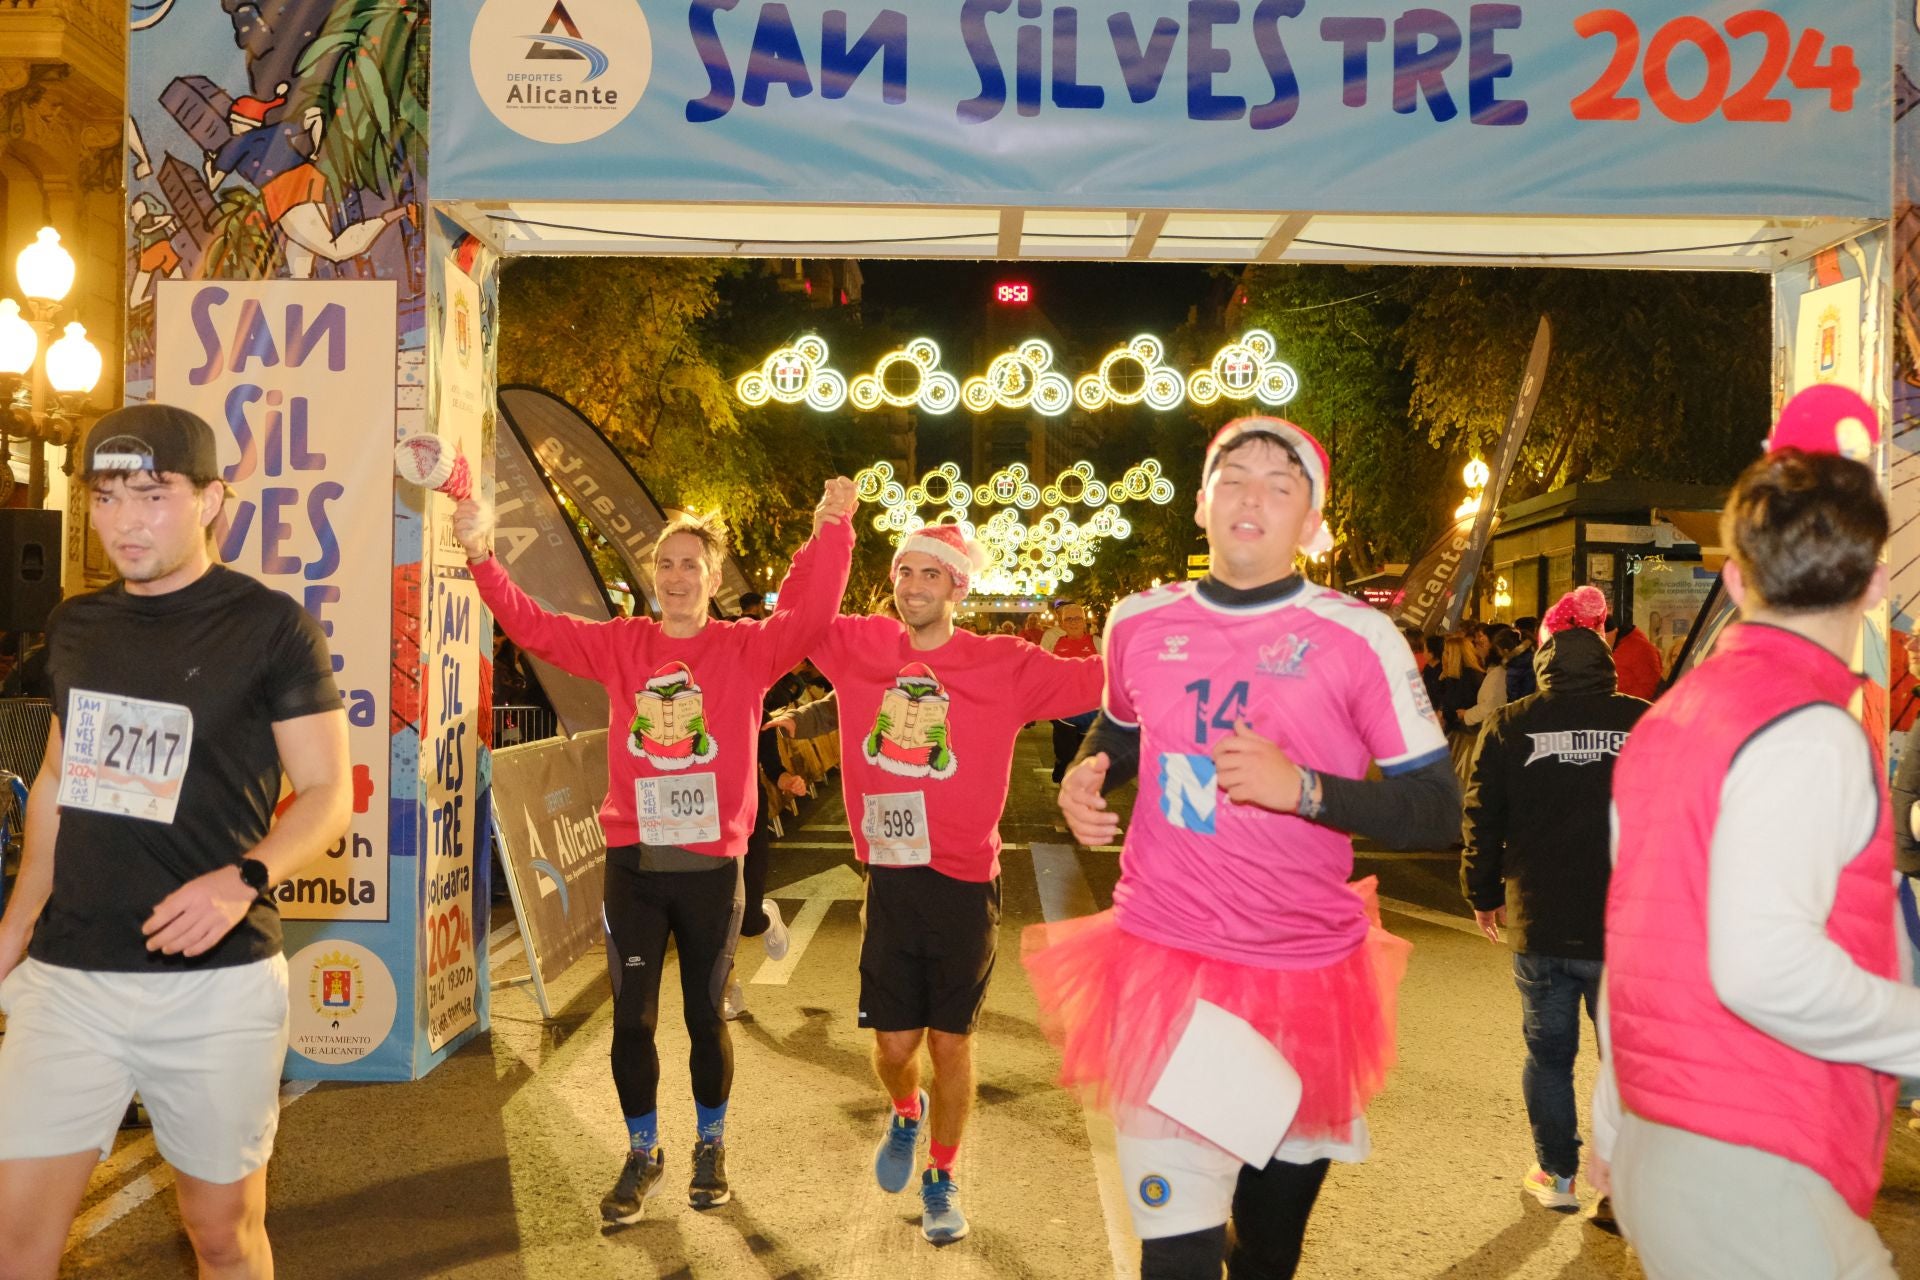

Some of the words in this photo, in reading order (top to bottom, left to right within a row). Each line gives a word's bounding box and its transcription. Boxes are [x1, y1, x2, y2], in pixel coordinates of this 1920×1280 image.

[507, 73, 563, 82] DEPORTES
[685, 0, 908, 123] SAN
[1570, 9, 1861, 123] 2024
[506, 83, 618, 104] Alicante
[997, 285, 1029, 302] 19:52
[189, 286, 346, 386] SAN
[1400, 536, 1472, 627] licante
[437, 582, 470, 655] SAN
[77, 697, 101, 712] SAN
[1185, 678, 1253, 744] 14
[74, 742, 93, 756] TRE
[76, 728, 96, 741] VES
[105, 724, 181, 777] 2717
[67, 762, 97, 778] 2024
[436, 722, 466, 793] VES
[671, 788, 704, 817] 599
[432, 795, 464, 859] TRE
[553, 804, 606, 869] Alicant
[883, 809, 915, 838] 598
[427, 865, 470, 909] solidaria
[428, 904, 472, 978] 2024
[298, 1034, 371, 1044] AYUNTAMIENTO
[304, 1046, 317, 1054] DE
[319, 1046, 365, 1056] ALICANTE
